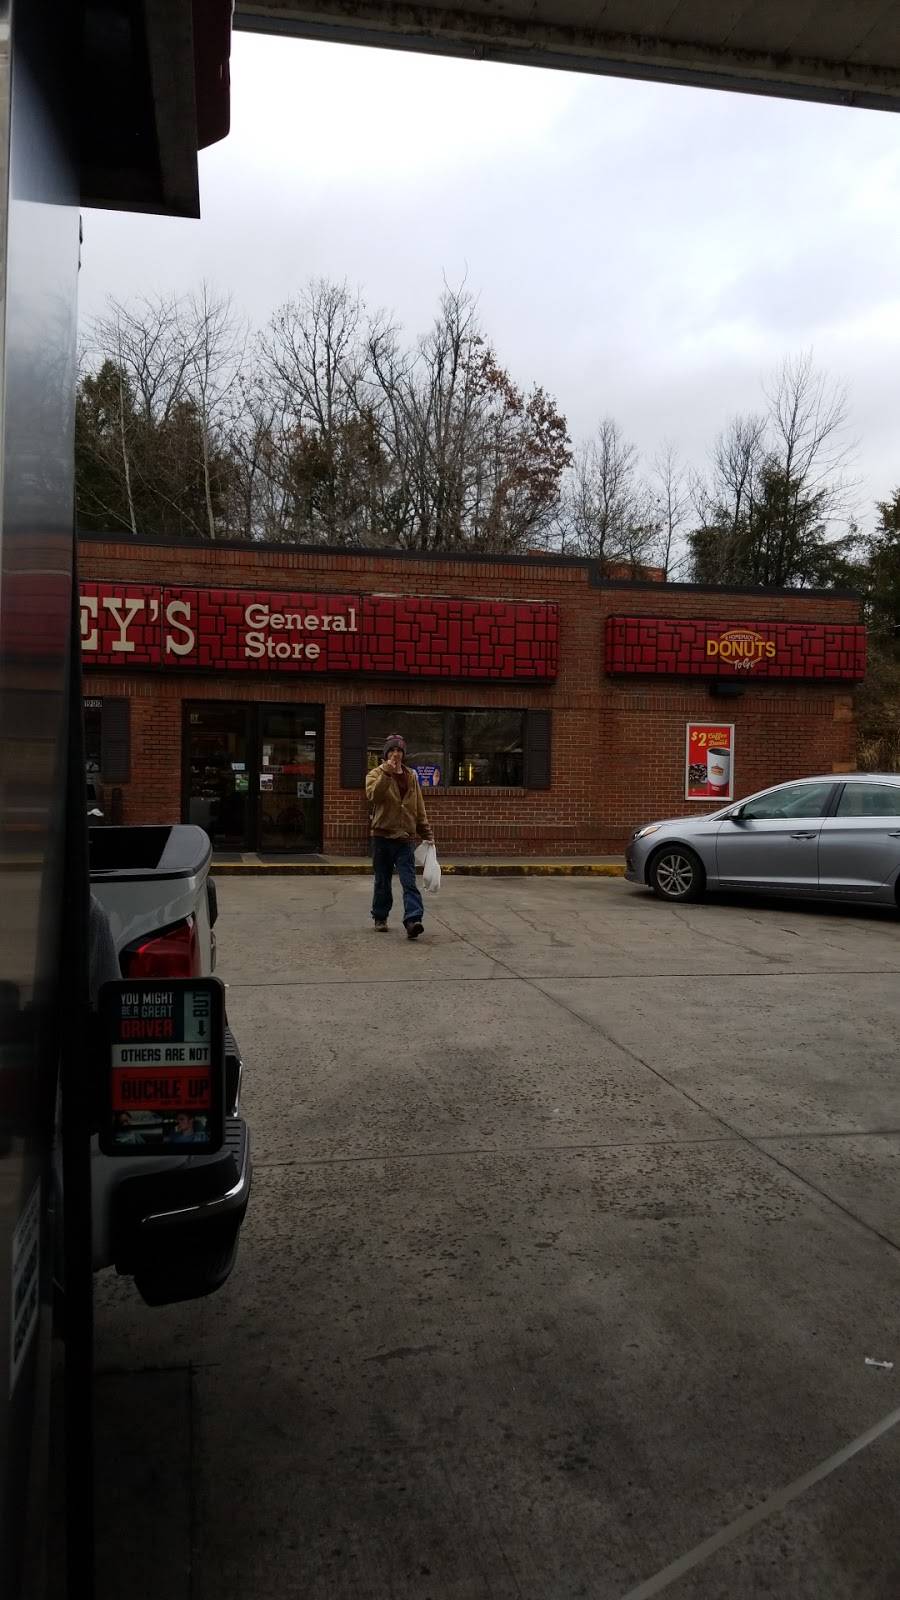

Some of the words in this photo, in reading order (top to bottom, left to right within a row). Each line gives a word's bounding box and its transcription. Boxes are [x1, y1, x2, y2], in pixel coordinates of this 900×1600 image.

[79, 596, 194, 655] EY'S
[245, 604, 357, 631] General
[245, 632, 320, 659] Store
[706, 640, 776, 657] DONUTS
[120, 992, 140, 1005] YOU
[142, 991, 174, 1005] MIGHT
[193, 992, 209, 1018] BUT
[132, 1006, 139, 1017] A
[140, 1005, 174, 1018] GREAT
[121, 1020, 174, 1040] DRIVER
[121, 1048, 161, 1062] OTHERS
[165, 1048, 185, 1061] ARE
[189, 1047, 209, 1061] NOT
[121, 1079, 181, 1099] BUCKLE
[188, 1079, 209, 1098] UP
